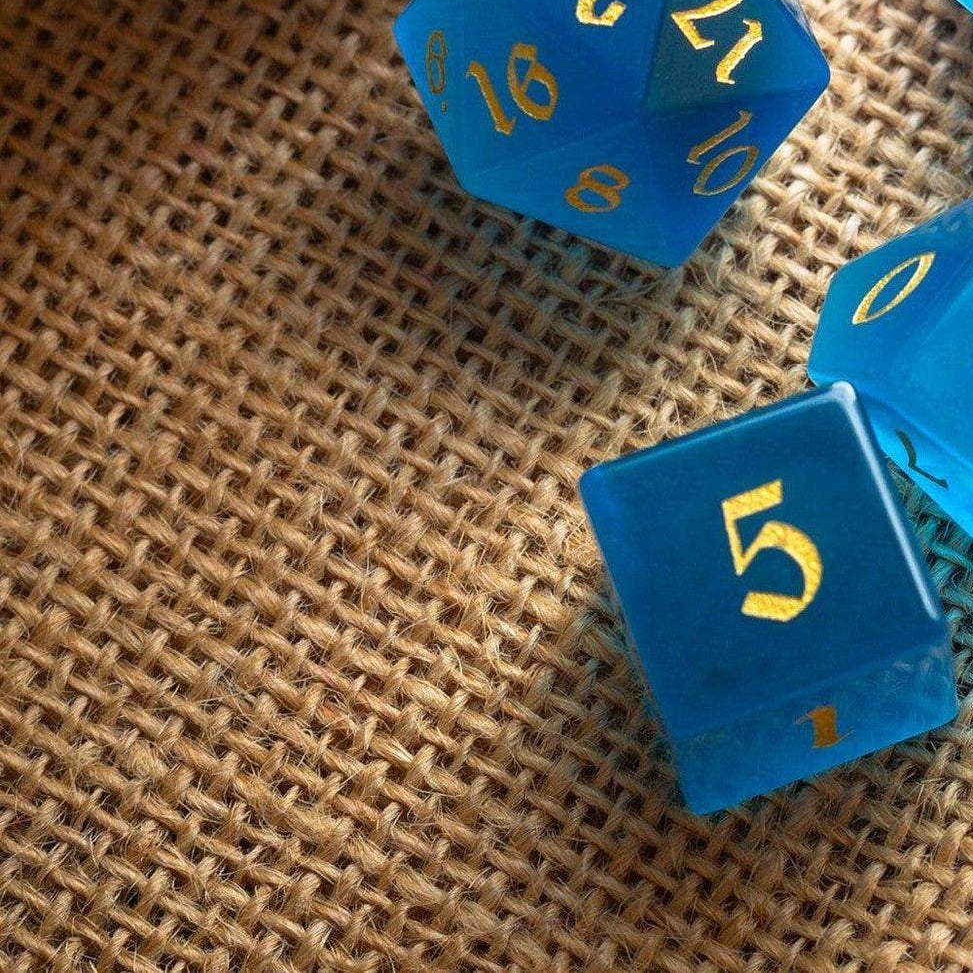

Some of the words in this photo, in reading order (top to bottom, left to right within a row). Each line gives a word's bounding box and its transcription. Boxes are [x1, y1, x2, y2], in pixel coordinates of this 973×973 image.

[466, 43, 559, 136] 16
[564, 164, 630, 213] 8
[687, 110, 758, 195] 10
[852, 251, 936, 325] 0
[721, 478, 823, 622] 5
[794, 703, 854, 749] 1
